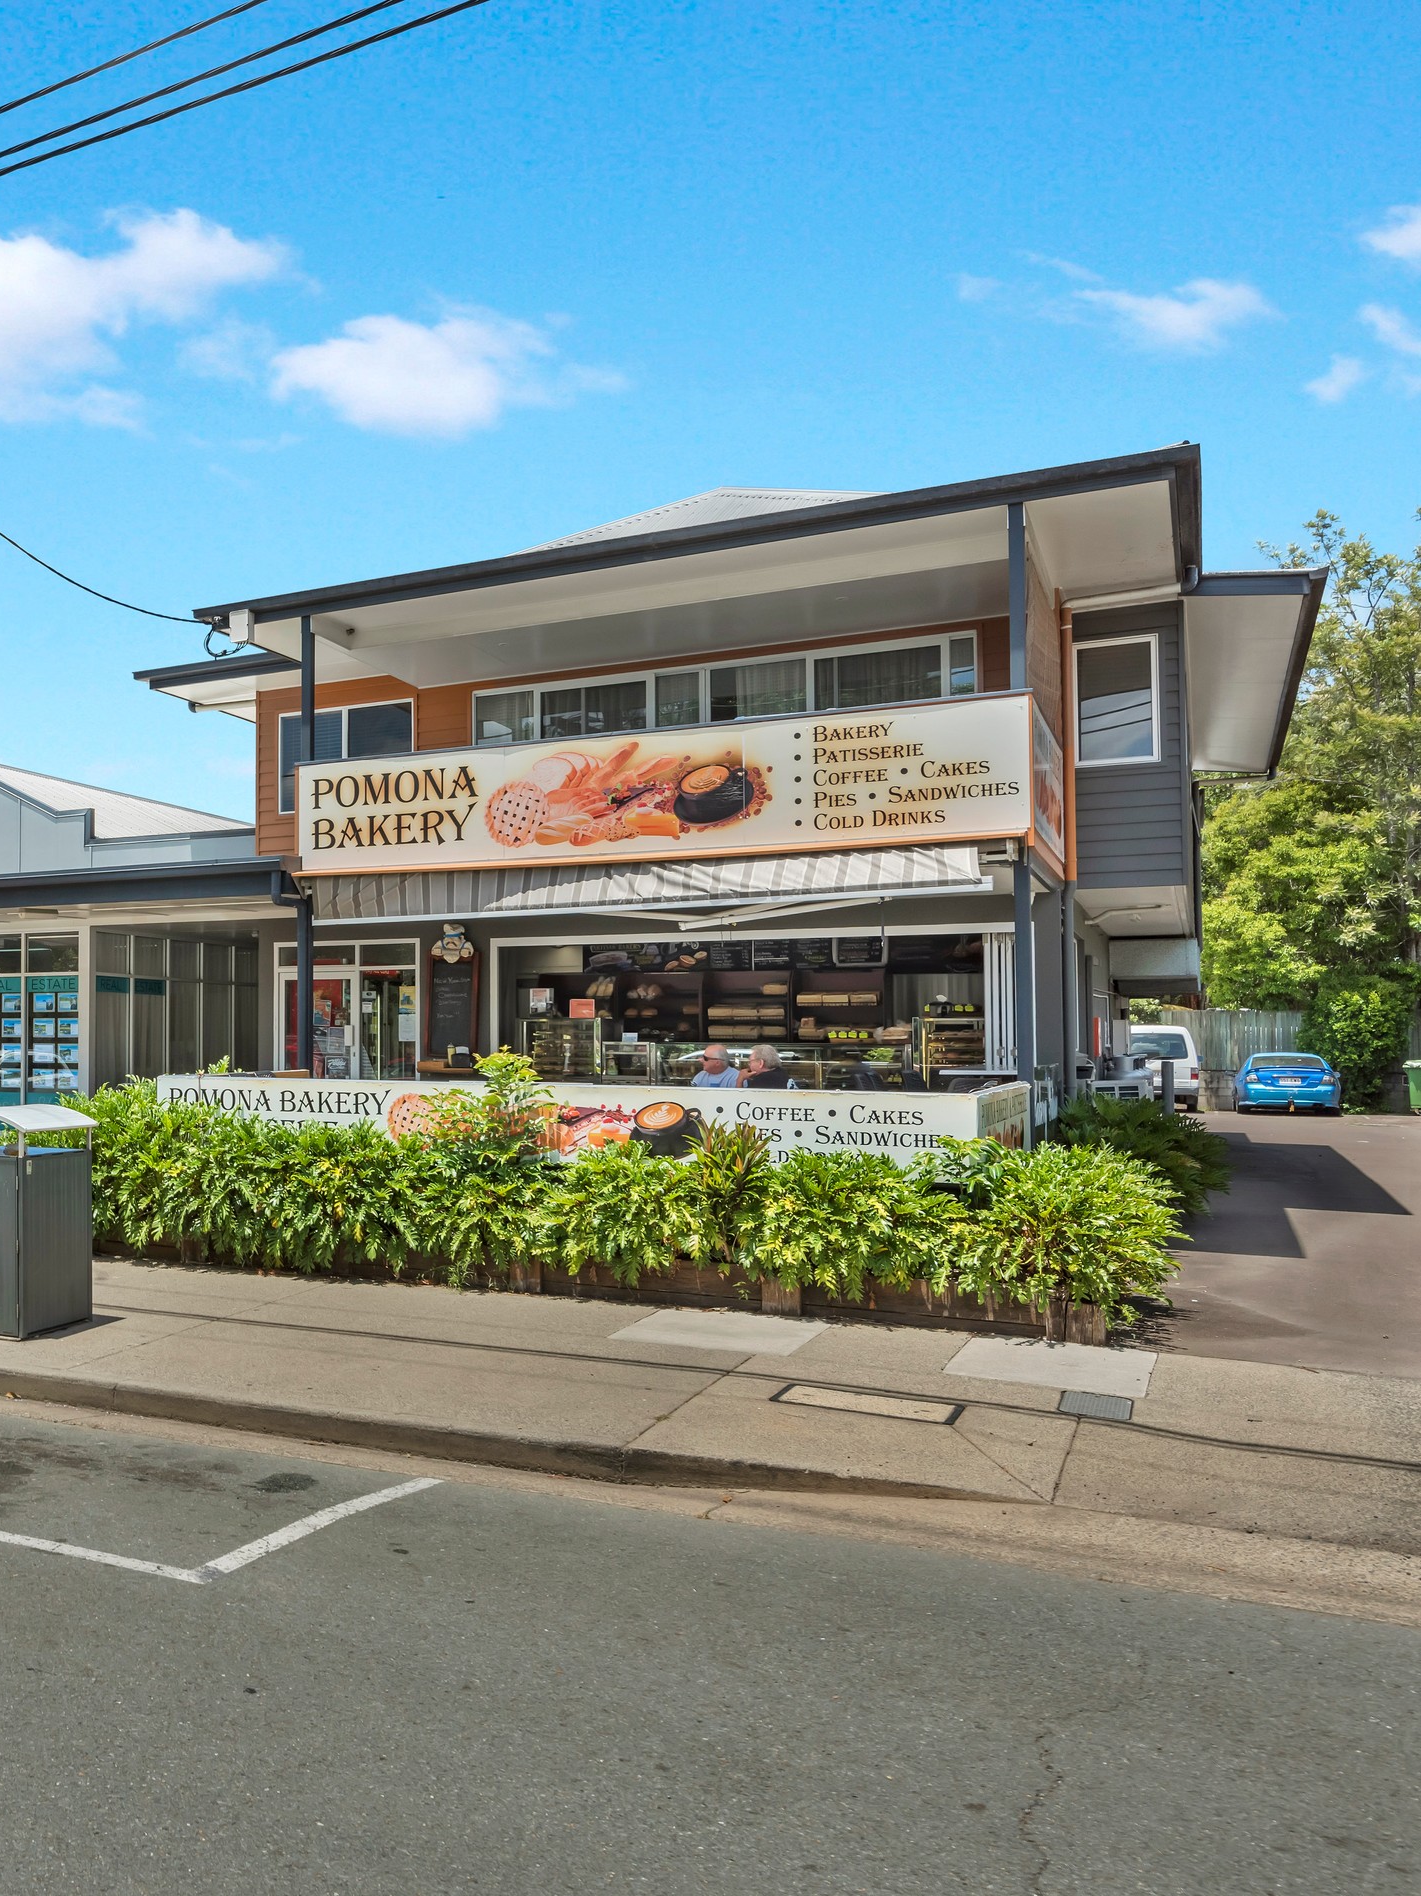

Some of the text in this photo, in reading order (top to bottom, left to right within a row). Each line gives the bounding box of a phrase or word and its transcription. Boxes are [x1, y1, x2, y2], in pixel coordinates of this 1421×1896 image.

[813, 720, 895, 743] BAKERY
[813, 743, 924, 765] PATISSERIE
[813, 760, 991, 787] COFFEE CAKES
[311, 766, 479, 810] POMONA
[813, 781, 1020, 808] PIES SANDWICHES
[311, 801, 478, 850] BAKERY
[814, 809, 946, 830] COLD DRINKS
[31, 978, 76, 990] ESTATE
[280, 1088, 392, 1116] BAKERY
[736, 1101, 924, 1126] COFFEE CAKES
